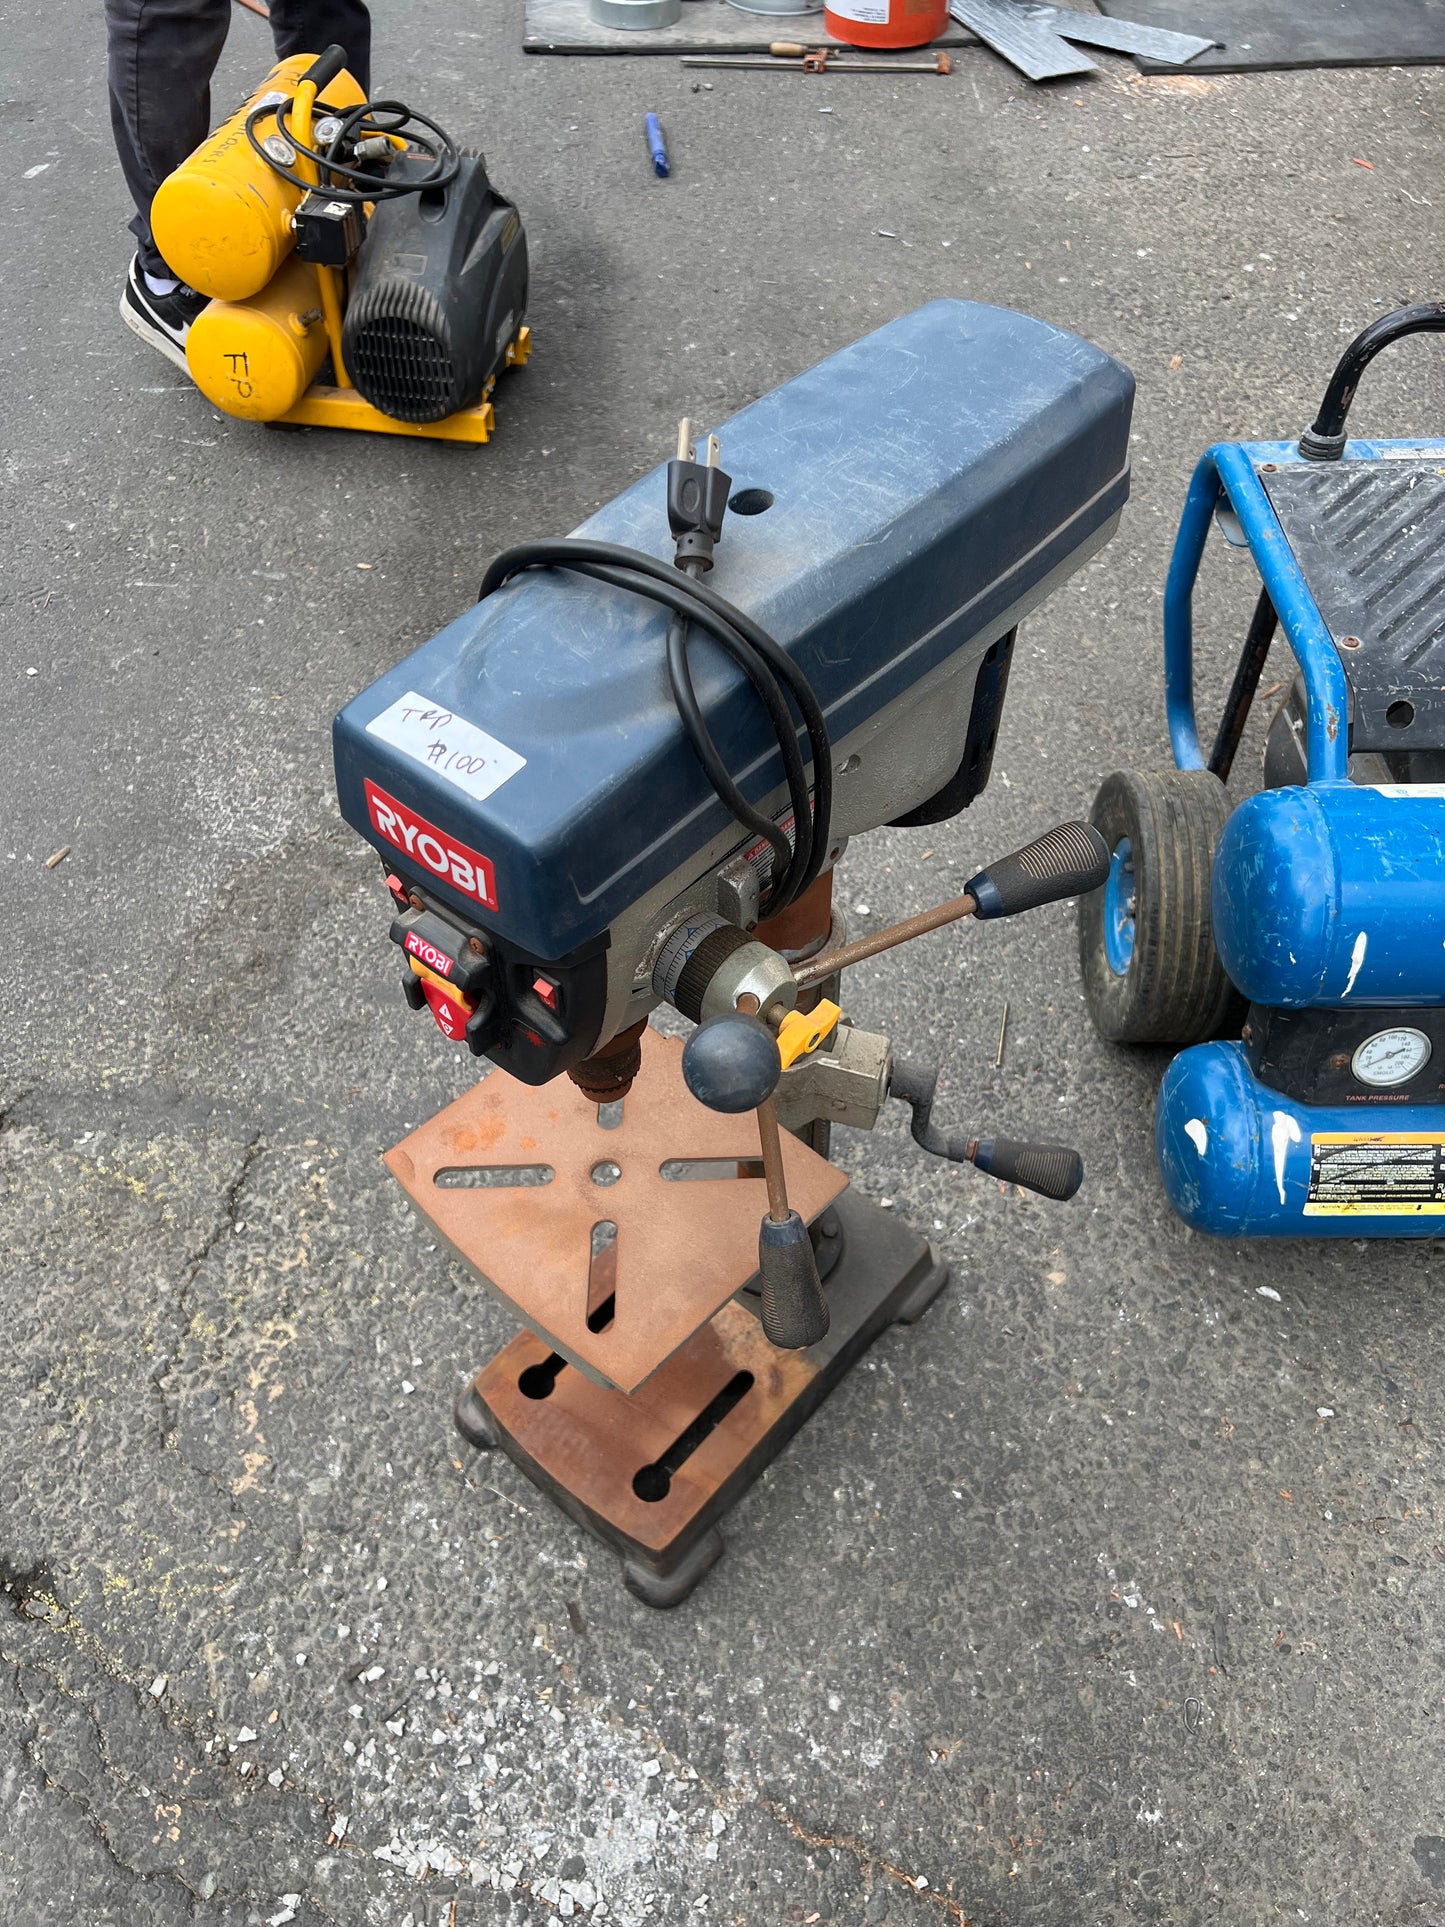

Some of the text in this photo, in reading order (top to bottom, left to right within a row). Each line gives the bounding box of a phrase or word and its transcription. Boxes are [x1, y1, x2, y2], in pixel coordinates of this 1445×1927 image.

[223, 352, 252, 398] FP
[428, 739, 485, 774] $100
[372, 795, 487, 901] RYOBI
[408, 934, 450, 974] RYOBI
